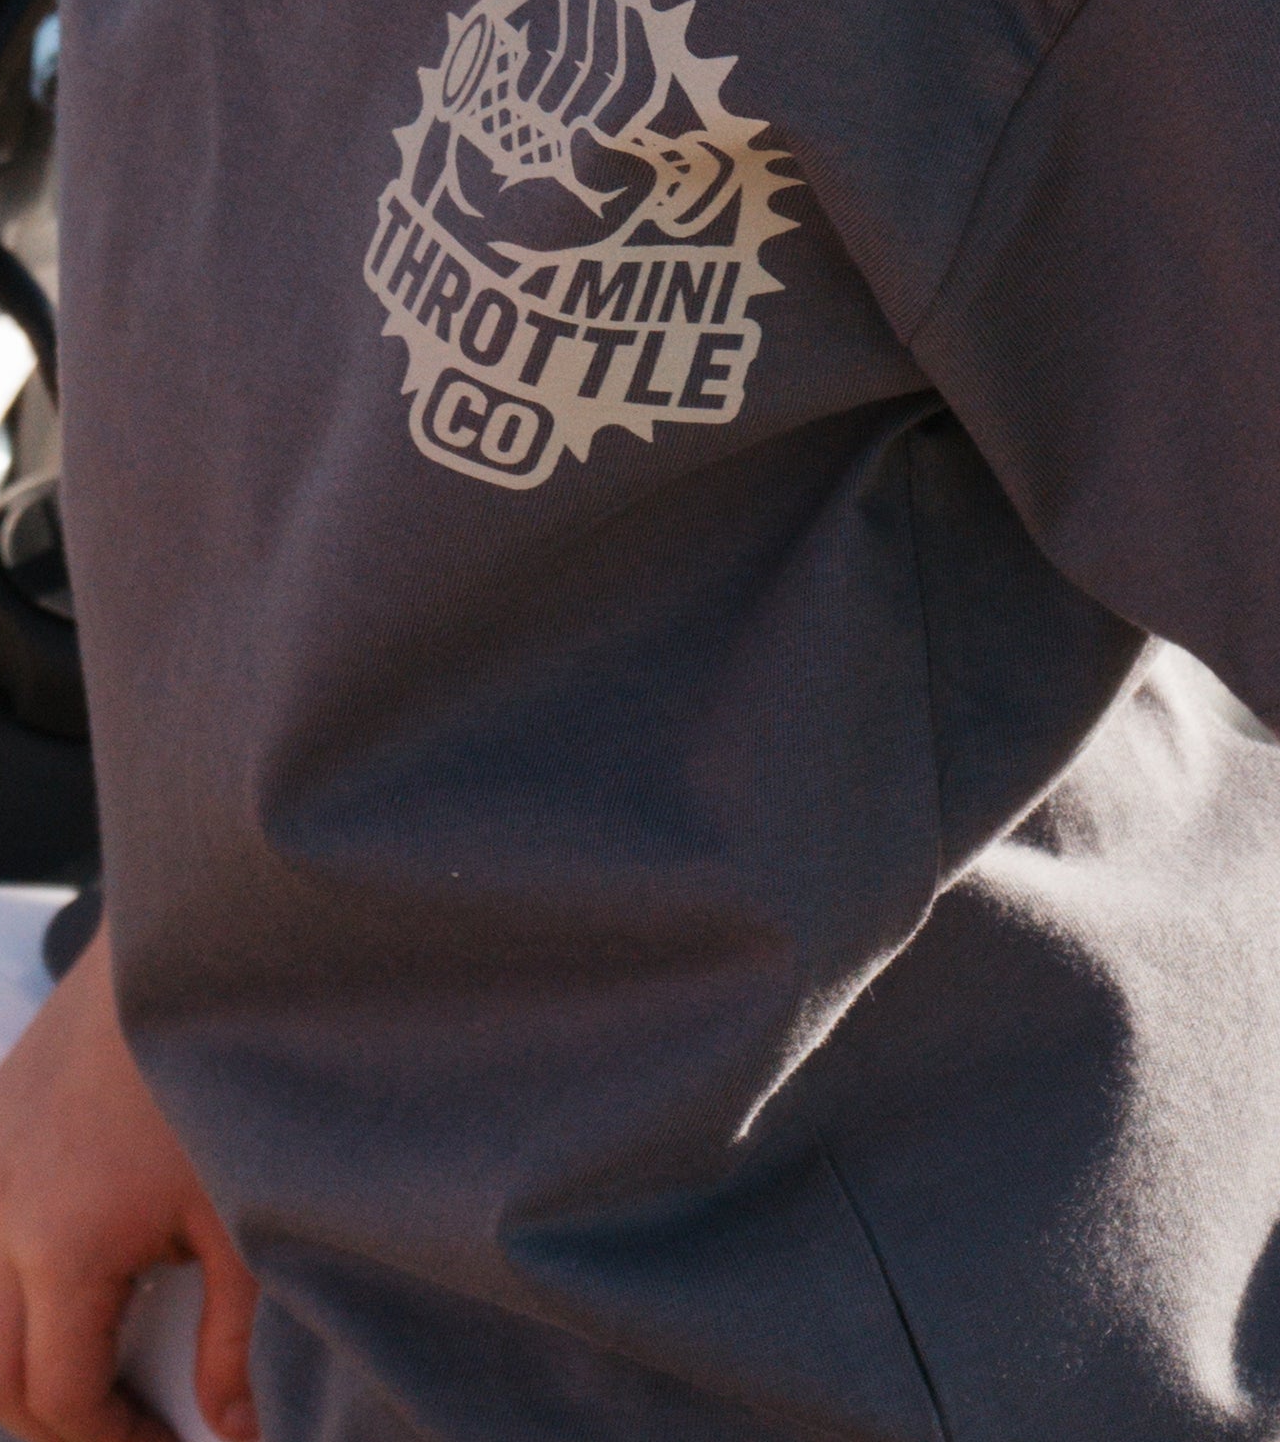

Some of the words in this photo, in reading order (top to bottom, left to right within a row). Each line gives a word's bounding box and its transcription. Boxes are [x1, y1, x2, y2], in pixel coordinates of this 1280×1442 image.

[371, 194, 746, 410] THROTTLE
[560, 259, 742, 325] MINI
[432, 380, 540, 464] CO
